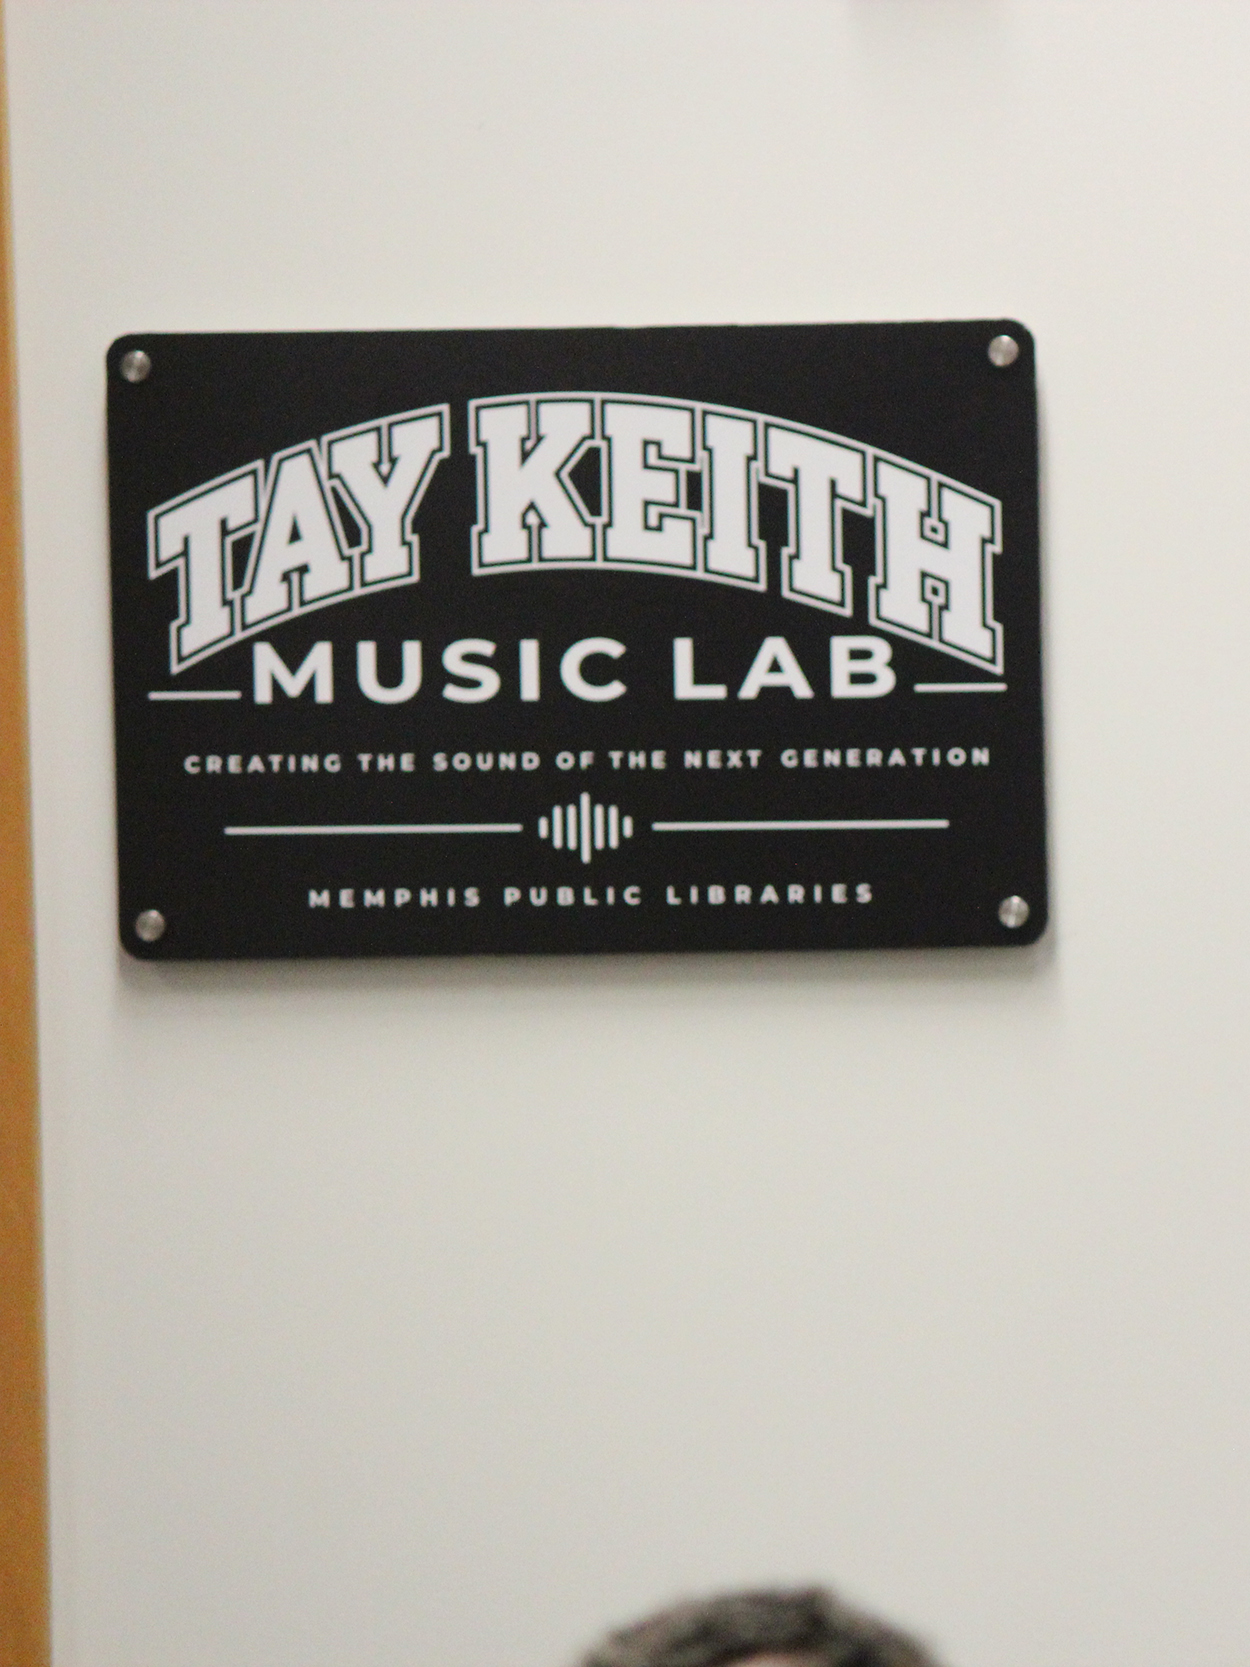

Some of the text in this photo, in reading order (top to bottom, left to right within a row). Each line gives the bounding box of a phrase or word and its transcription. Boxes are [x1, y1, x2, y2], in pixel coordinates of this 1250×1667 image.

[147, 391, 1004, 675] TAY KEITH
[253, 636, 898, 705] MUSIC LAB
[184, 746, 991, 774] CREATING THE SOUND OF THE NEXT GENERATION
[308, 883, 873, 908] MEMPHIS PUBLIC LIBRARIES
